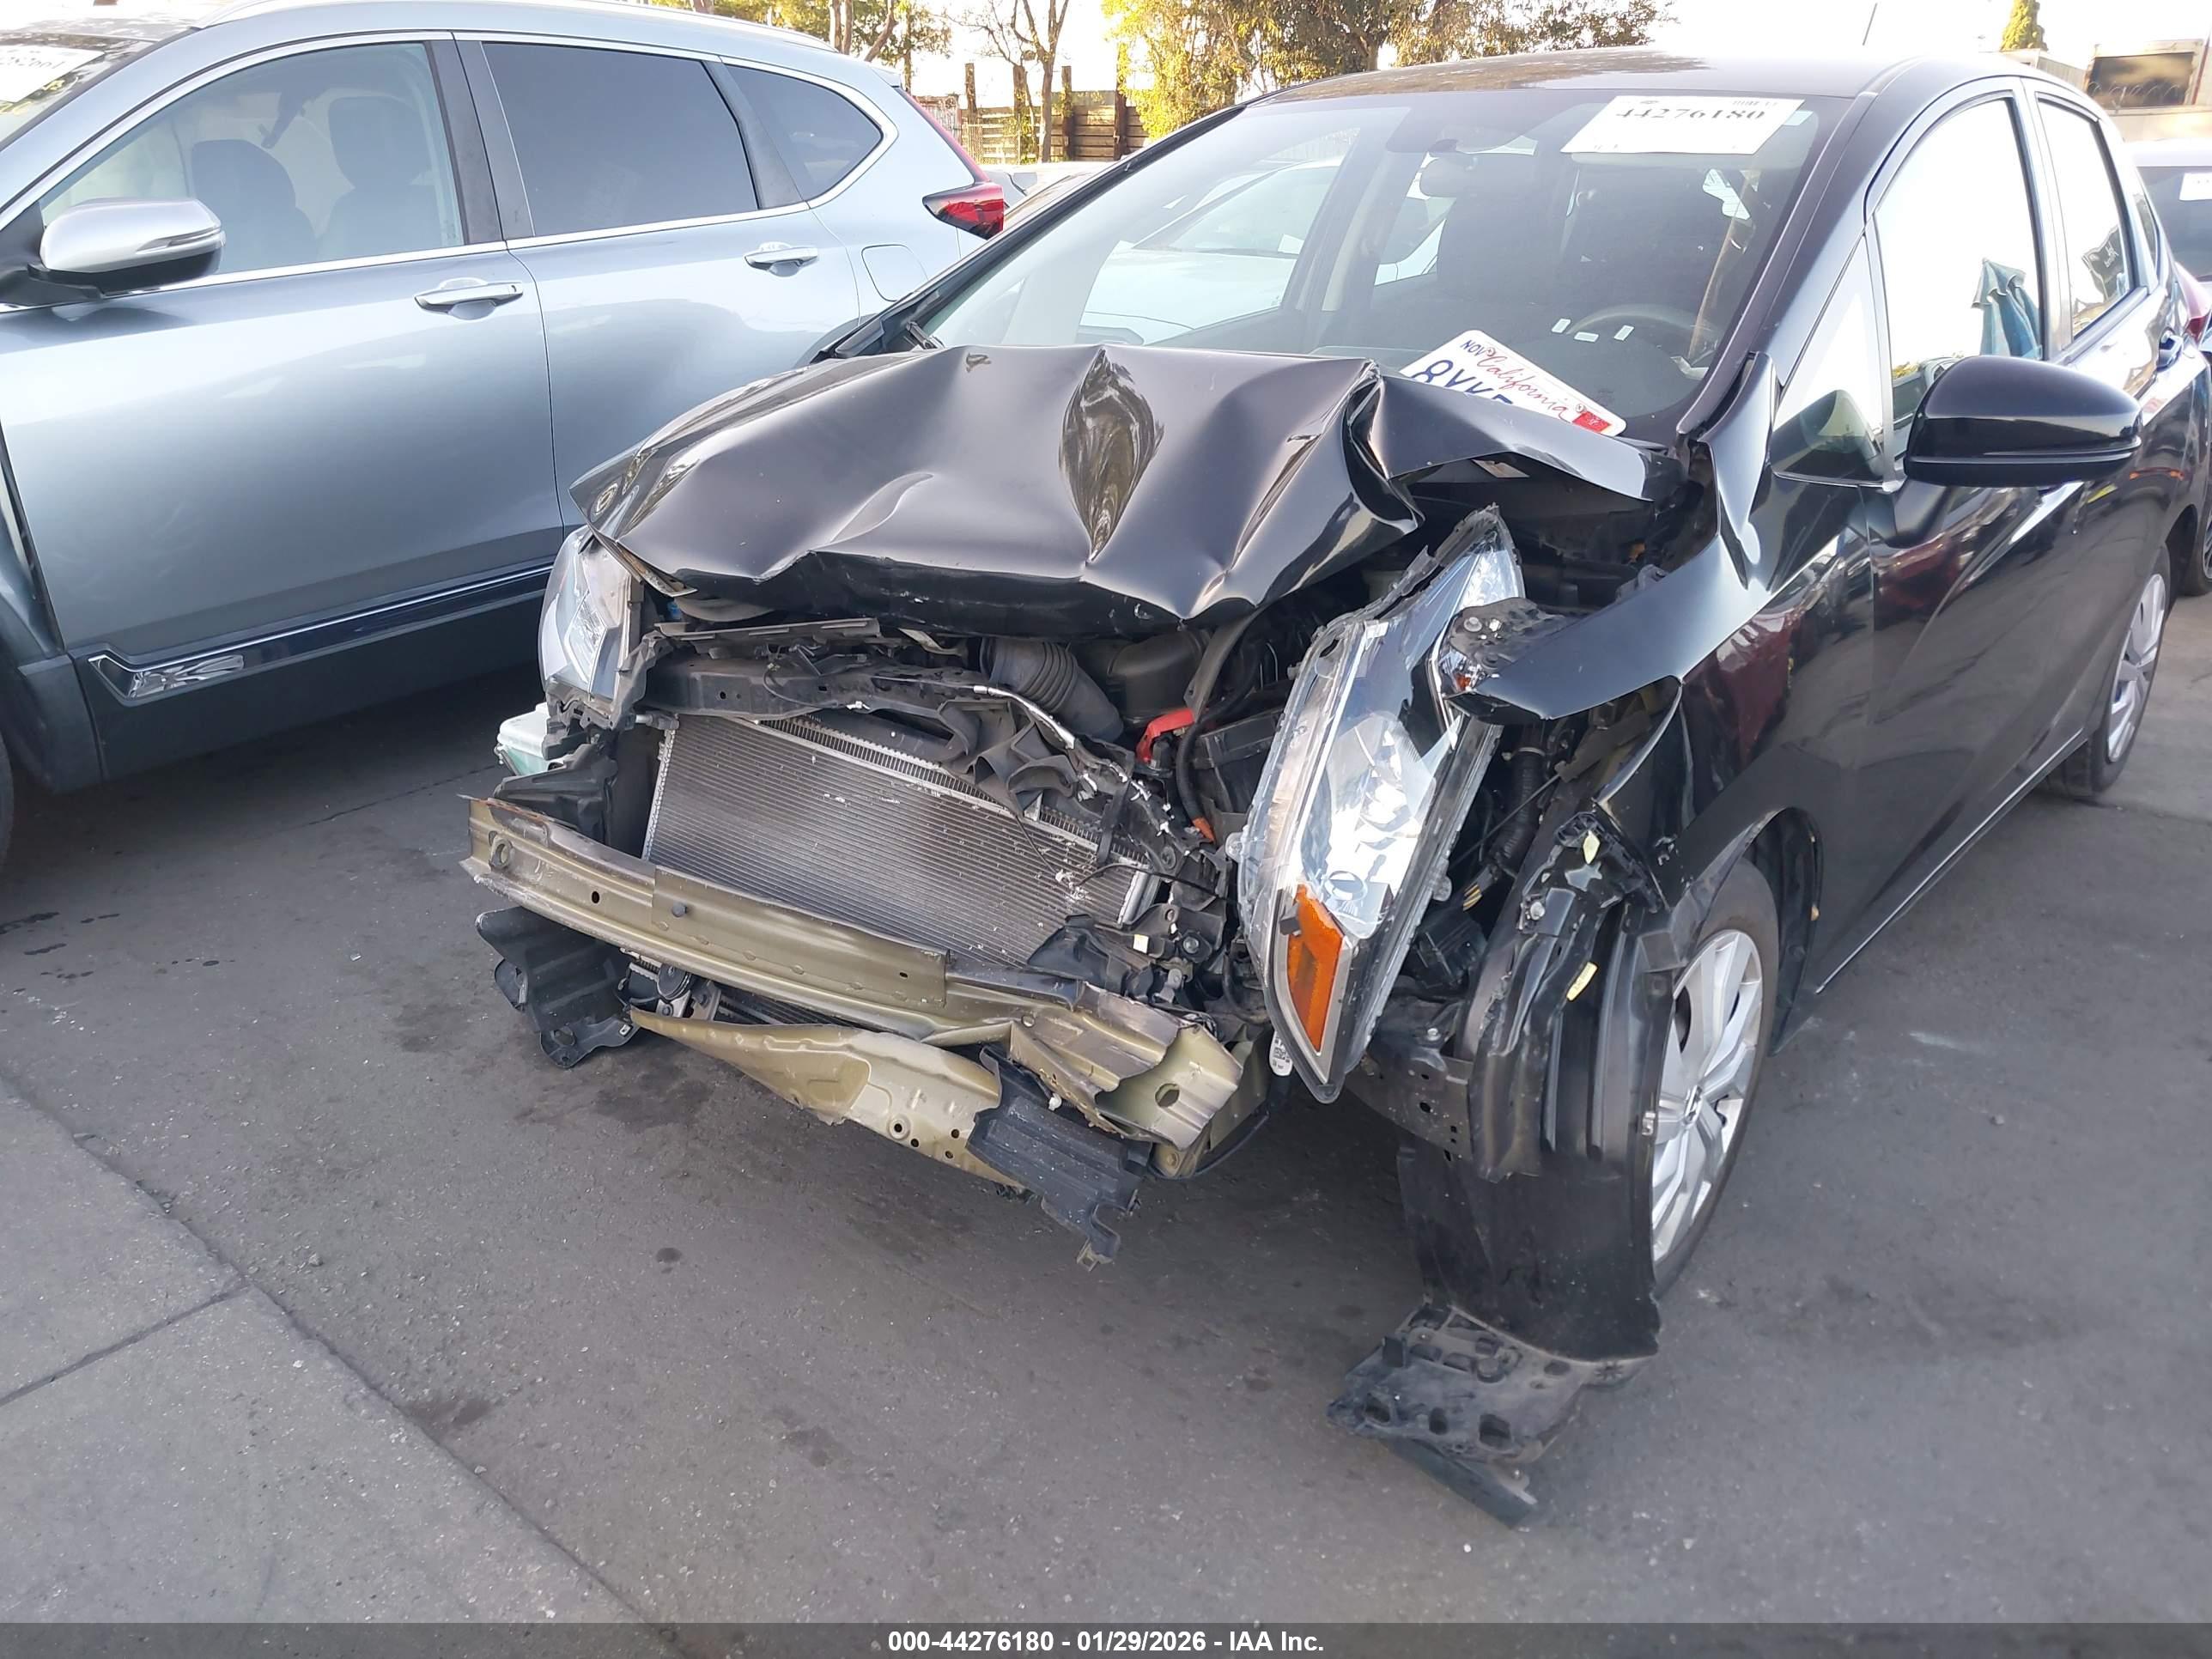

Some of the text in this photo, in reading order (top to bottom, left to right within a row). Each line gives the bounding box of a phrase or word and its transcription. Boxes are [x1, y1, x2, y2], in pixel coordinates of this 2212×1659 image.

[1615, 108, 1765, 119] 44276180
[1461, 340, 1486, 356] NOV
[1477, 356, 1571, 424] California
